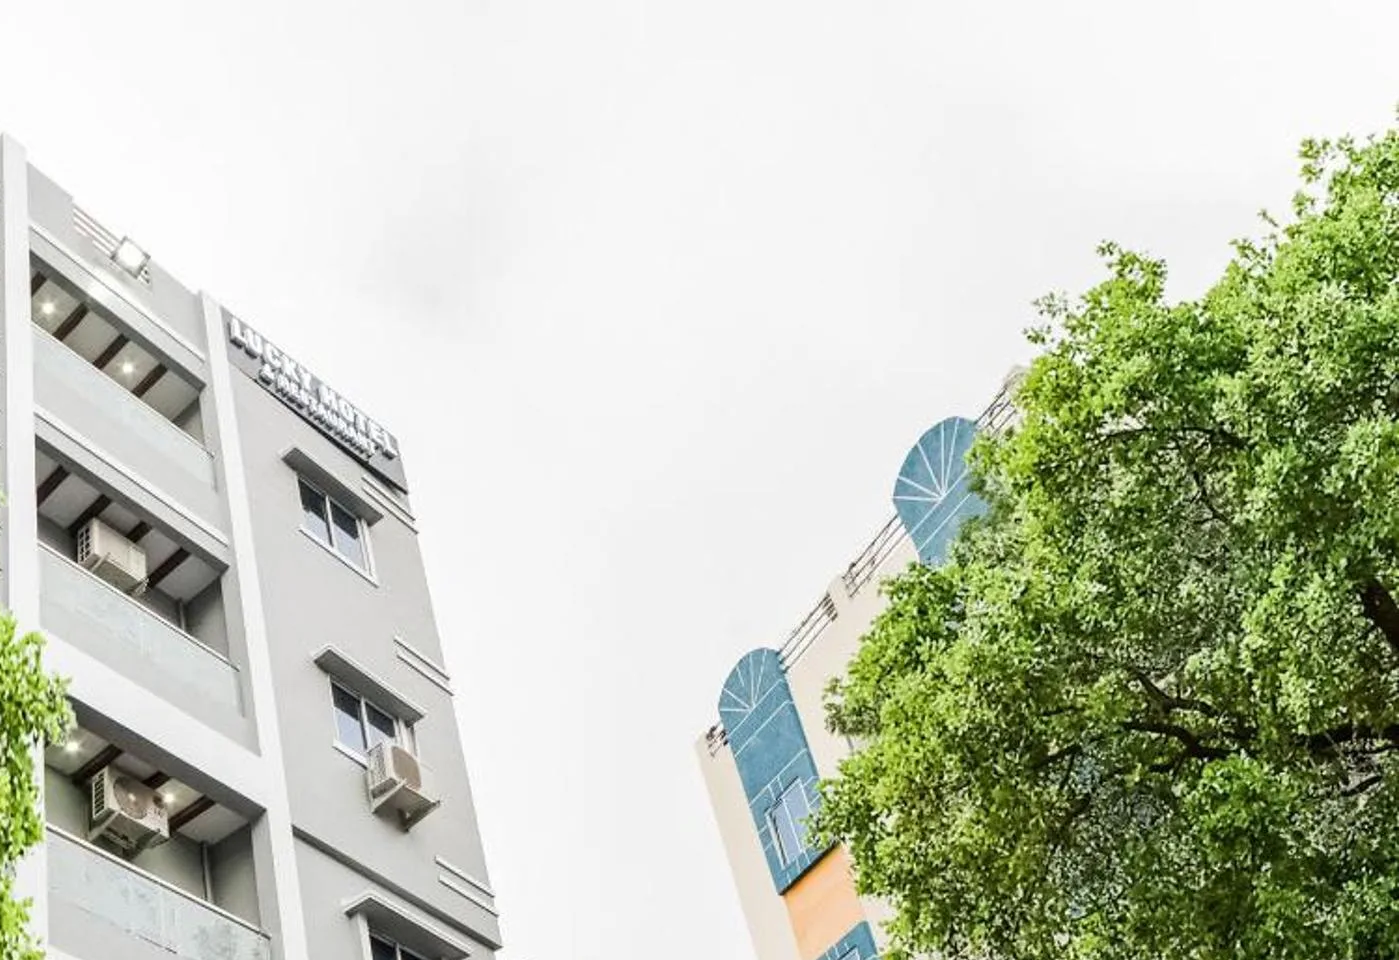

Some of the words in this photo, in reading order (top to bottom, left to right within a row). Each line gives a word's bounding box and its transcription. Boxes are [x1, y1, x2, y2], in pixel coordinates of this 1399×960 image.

[228, 316, 311, 391] LUCKY
[317, 384, 398, 460] HOTEL
[259, 363, 275, 386] &
[276, 374, 375, 459] RESTAURANT
